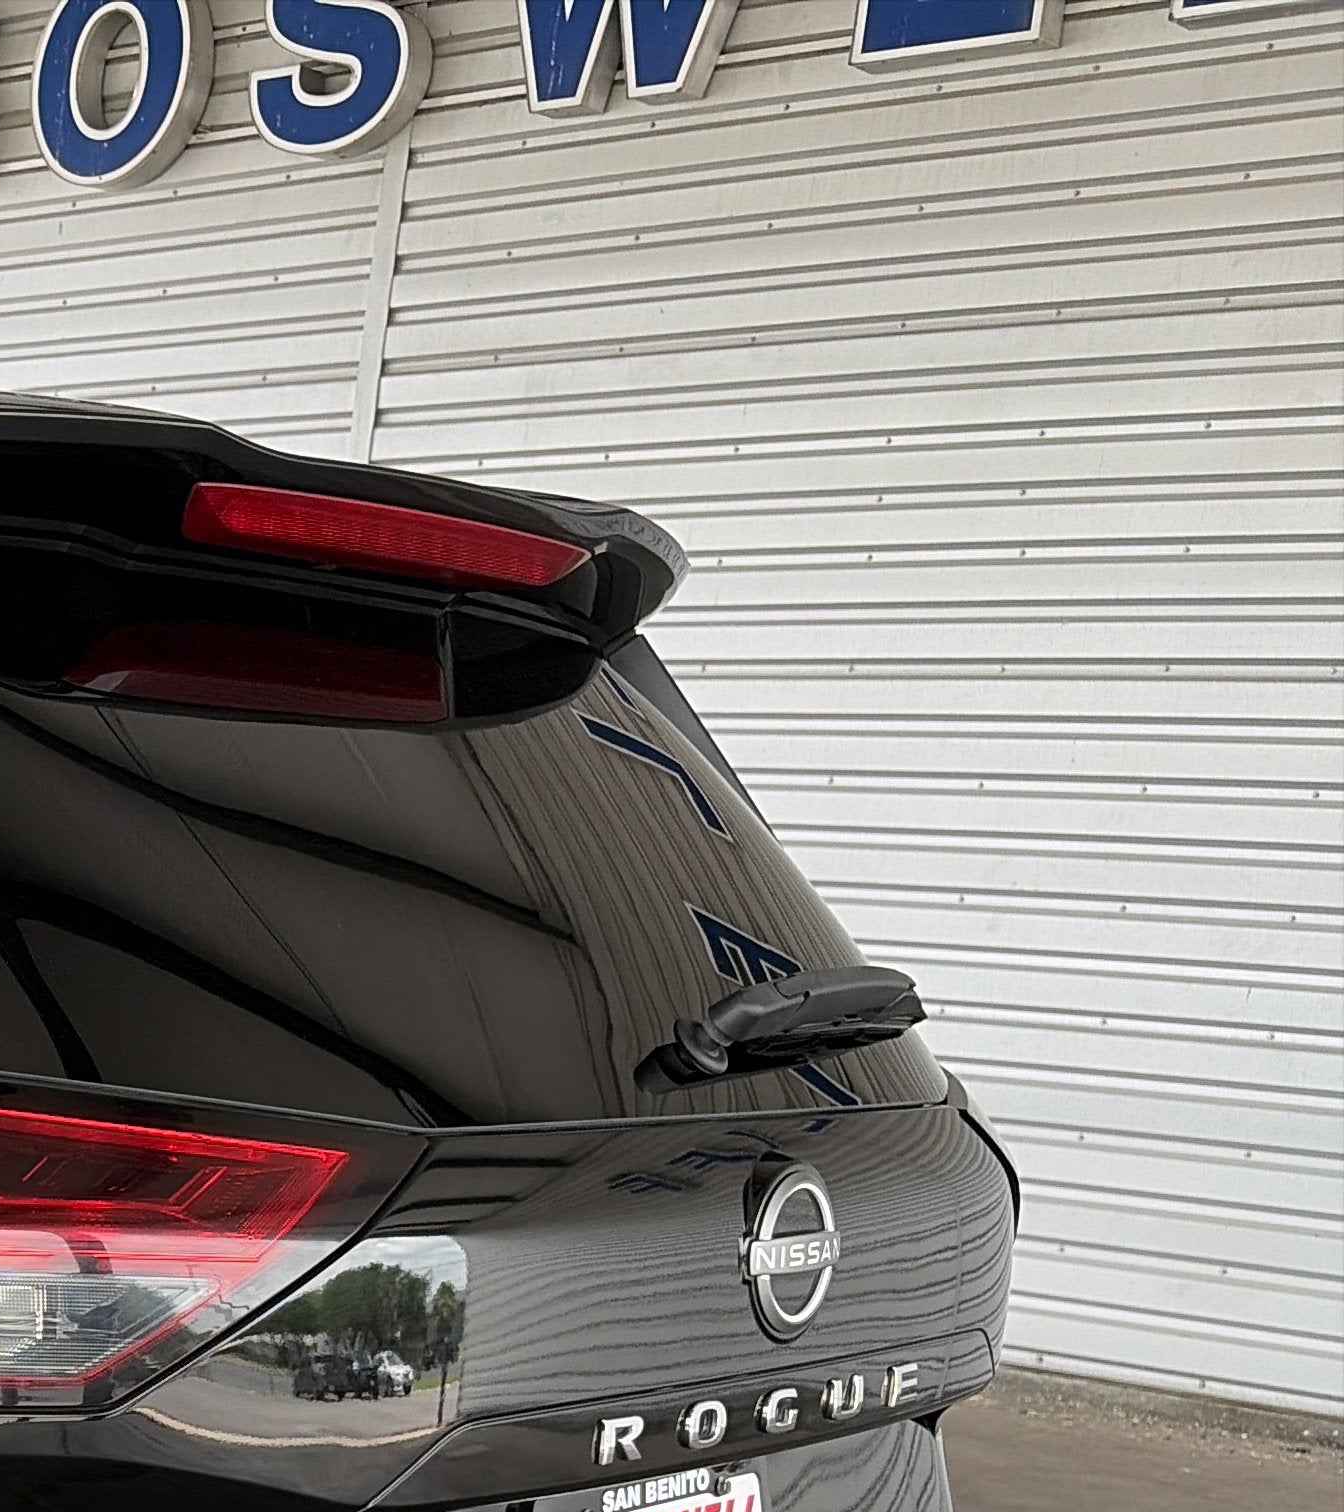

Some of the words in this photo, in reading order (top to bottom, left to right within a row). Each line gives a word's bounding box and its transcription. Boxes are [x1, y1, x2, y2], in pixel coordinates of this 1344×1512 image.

[755, 1238, 840, 1270] NISSAN
[592, 1362, 918, 1466] ROGUE
[645, 1468, 710, 1504] BENITO
